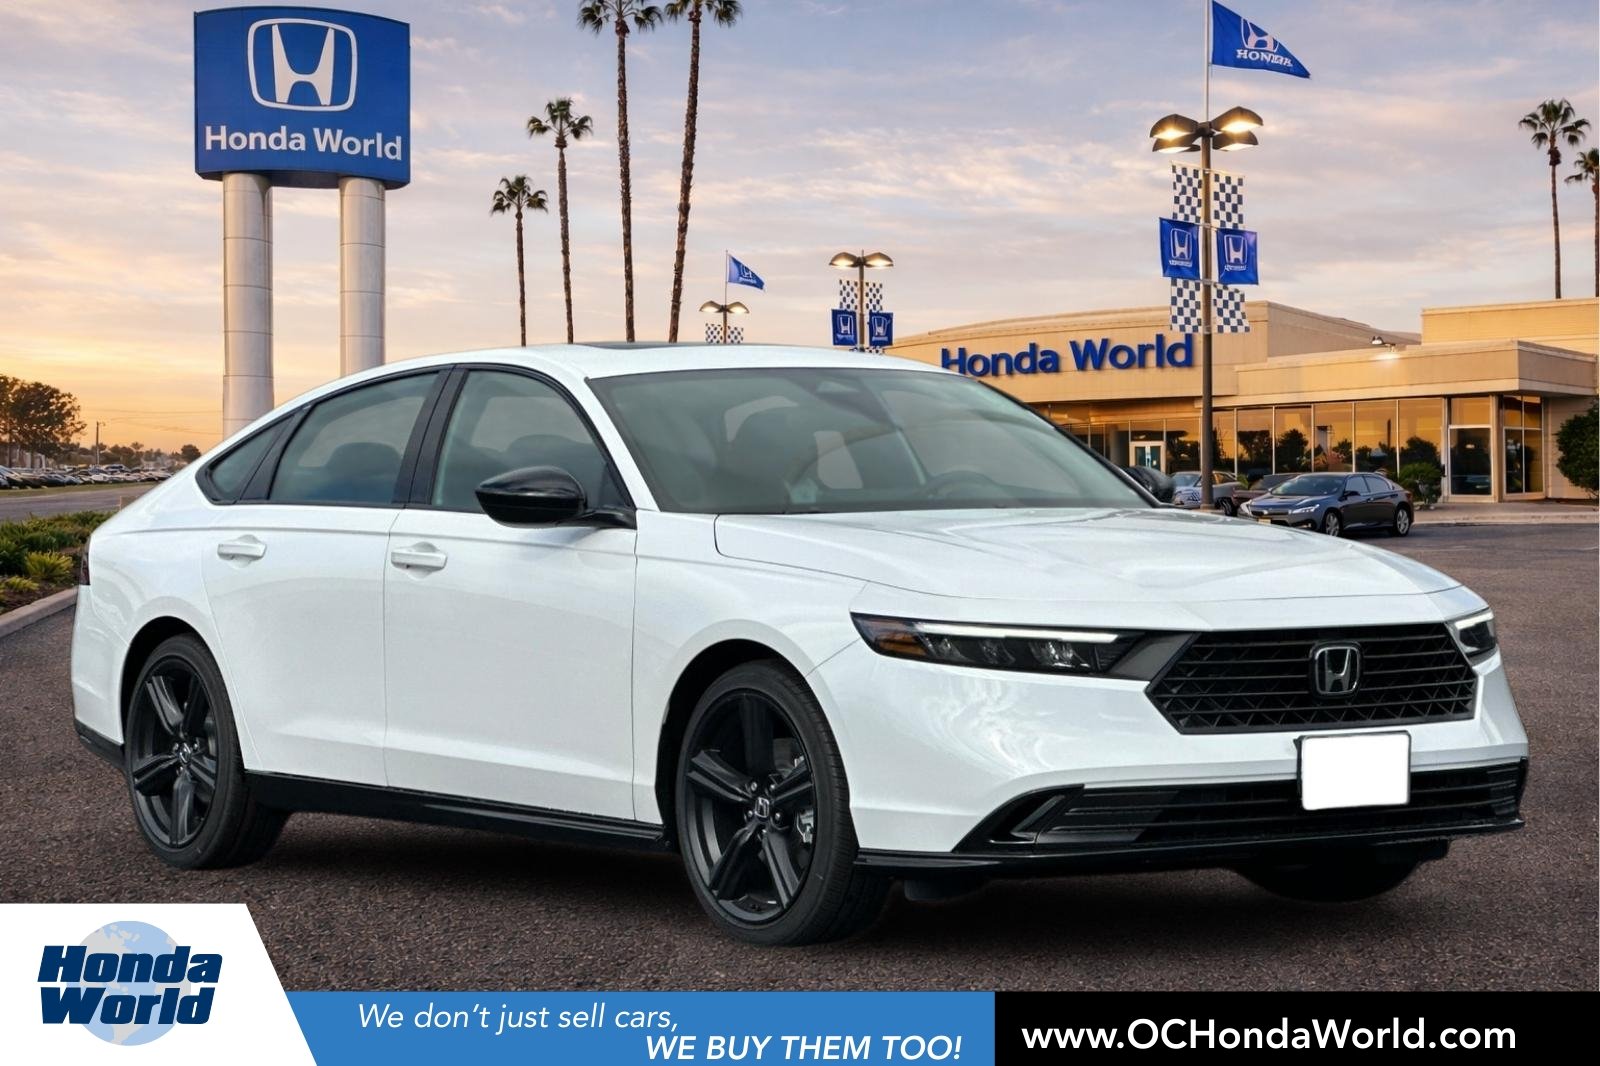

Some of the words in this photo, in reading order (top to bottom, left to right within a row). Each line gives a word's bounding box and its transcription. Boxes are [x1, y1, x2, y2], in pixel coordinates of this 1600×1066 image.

[205, 125, 306, 151] Honda
[313, 127, 402, 161] World
[941, 342, 1061, 378] Honda
[1069, 333, 1194, 371] World
